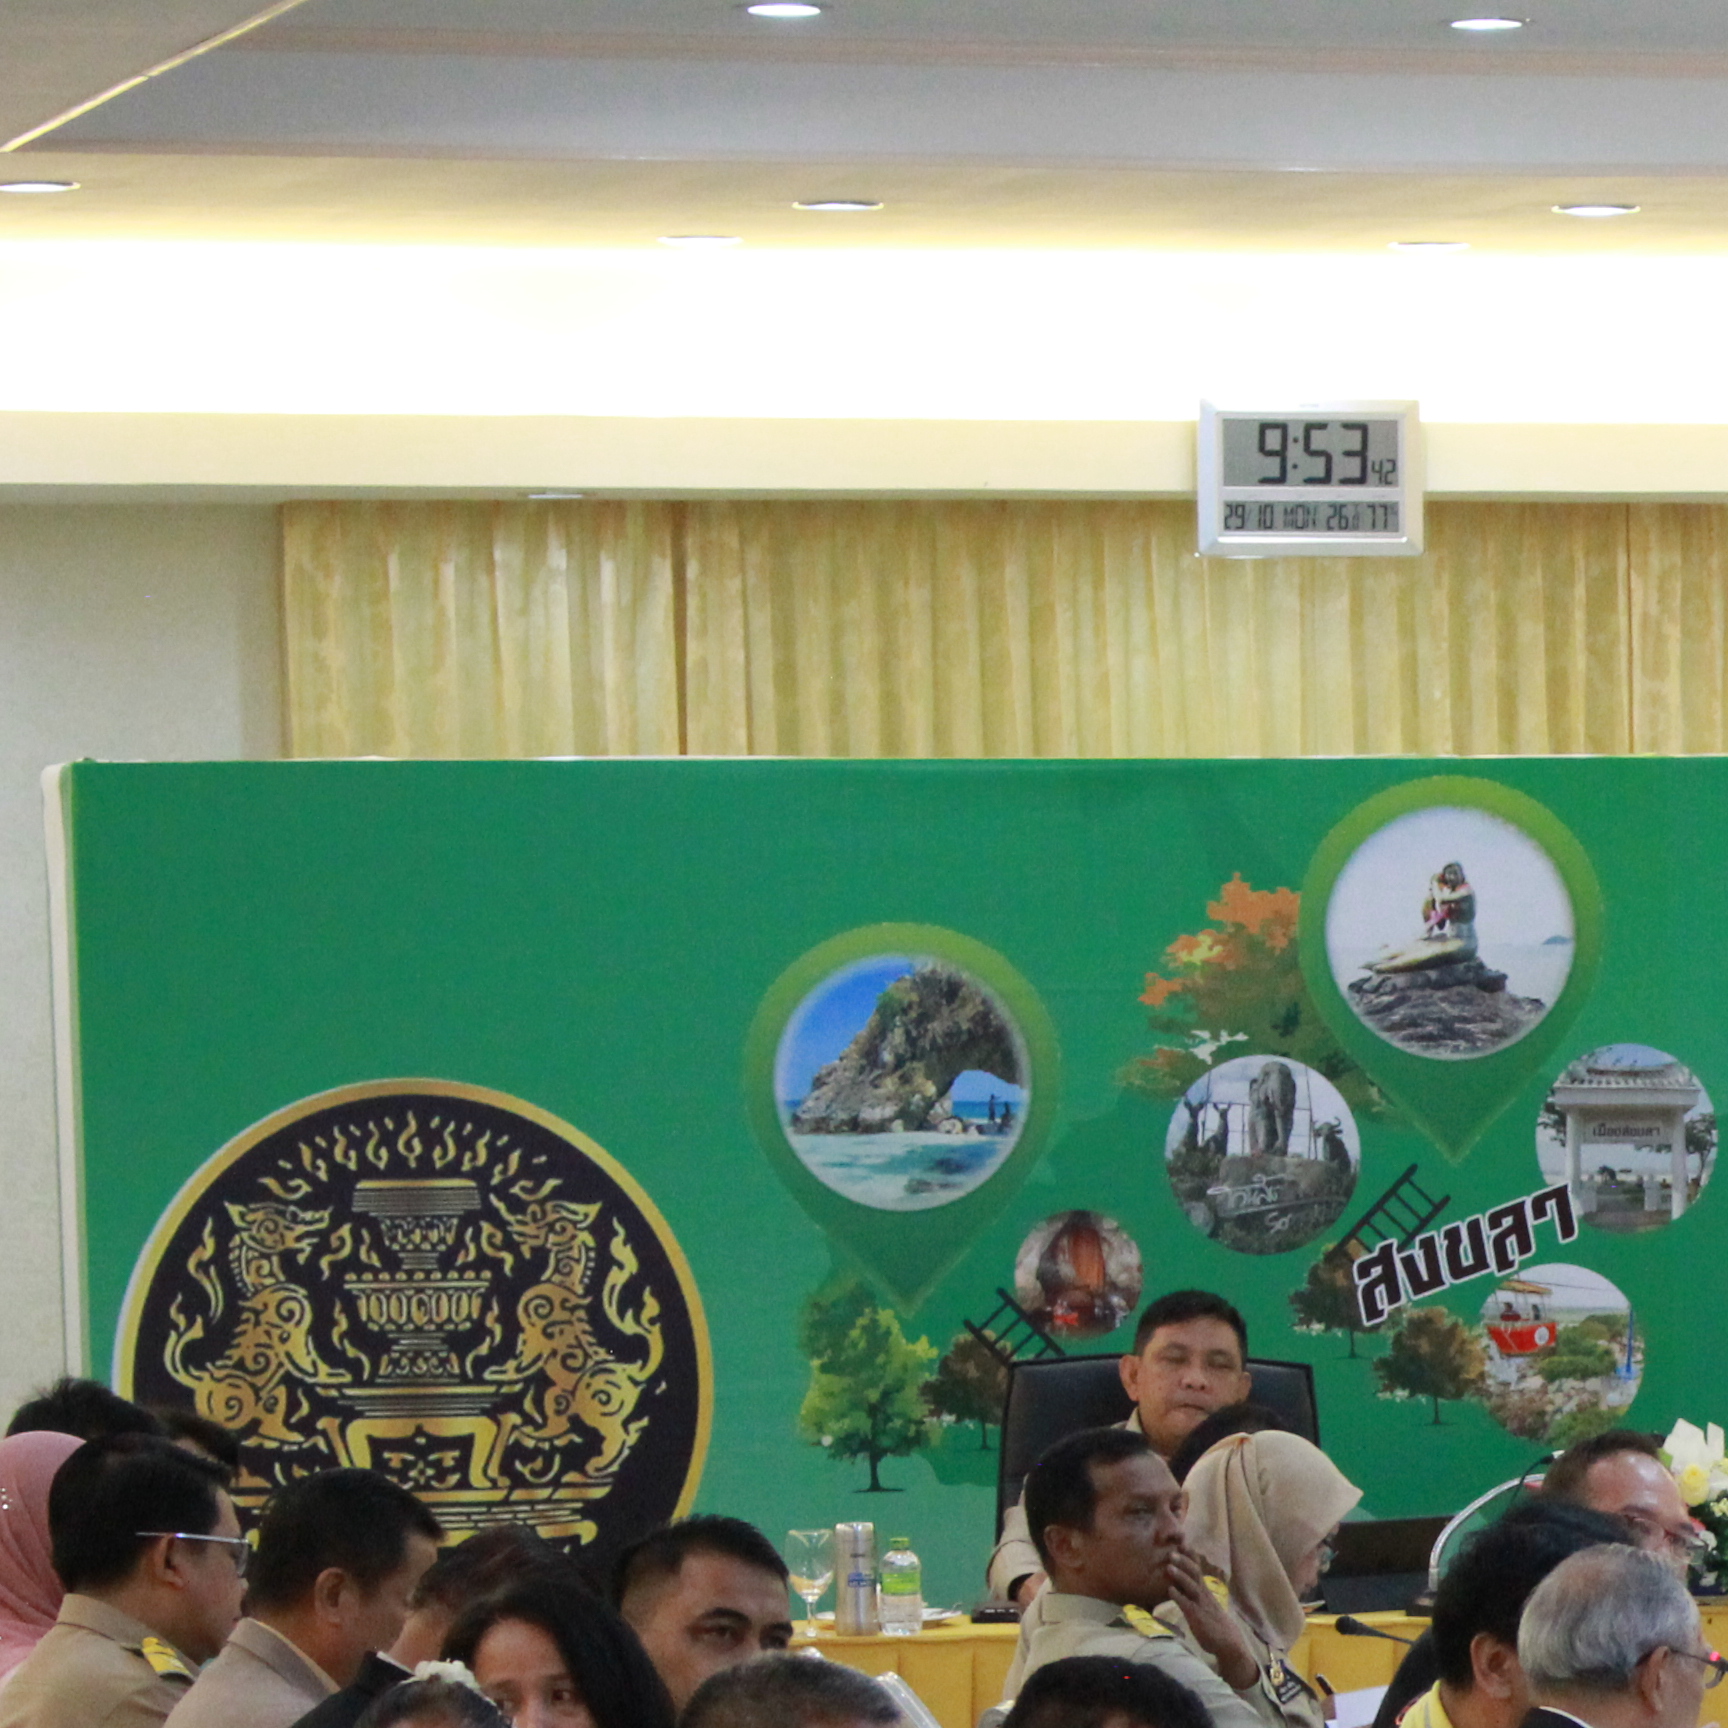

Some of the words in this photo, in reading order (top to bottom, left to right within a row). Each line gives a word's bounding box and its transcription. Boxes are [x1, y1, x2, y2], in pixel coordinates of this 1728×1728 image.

[1257, 422, 1369, 485] 9:53
[1371, 459, 1396, 485] 42
[1283, 504, 1317, 530] MON
[1353, 1182, 1580, 1326] สงขลา
